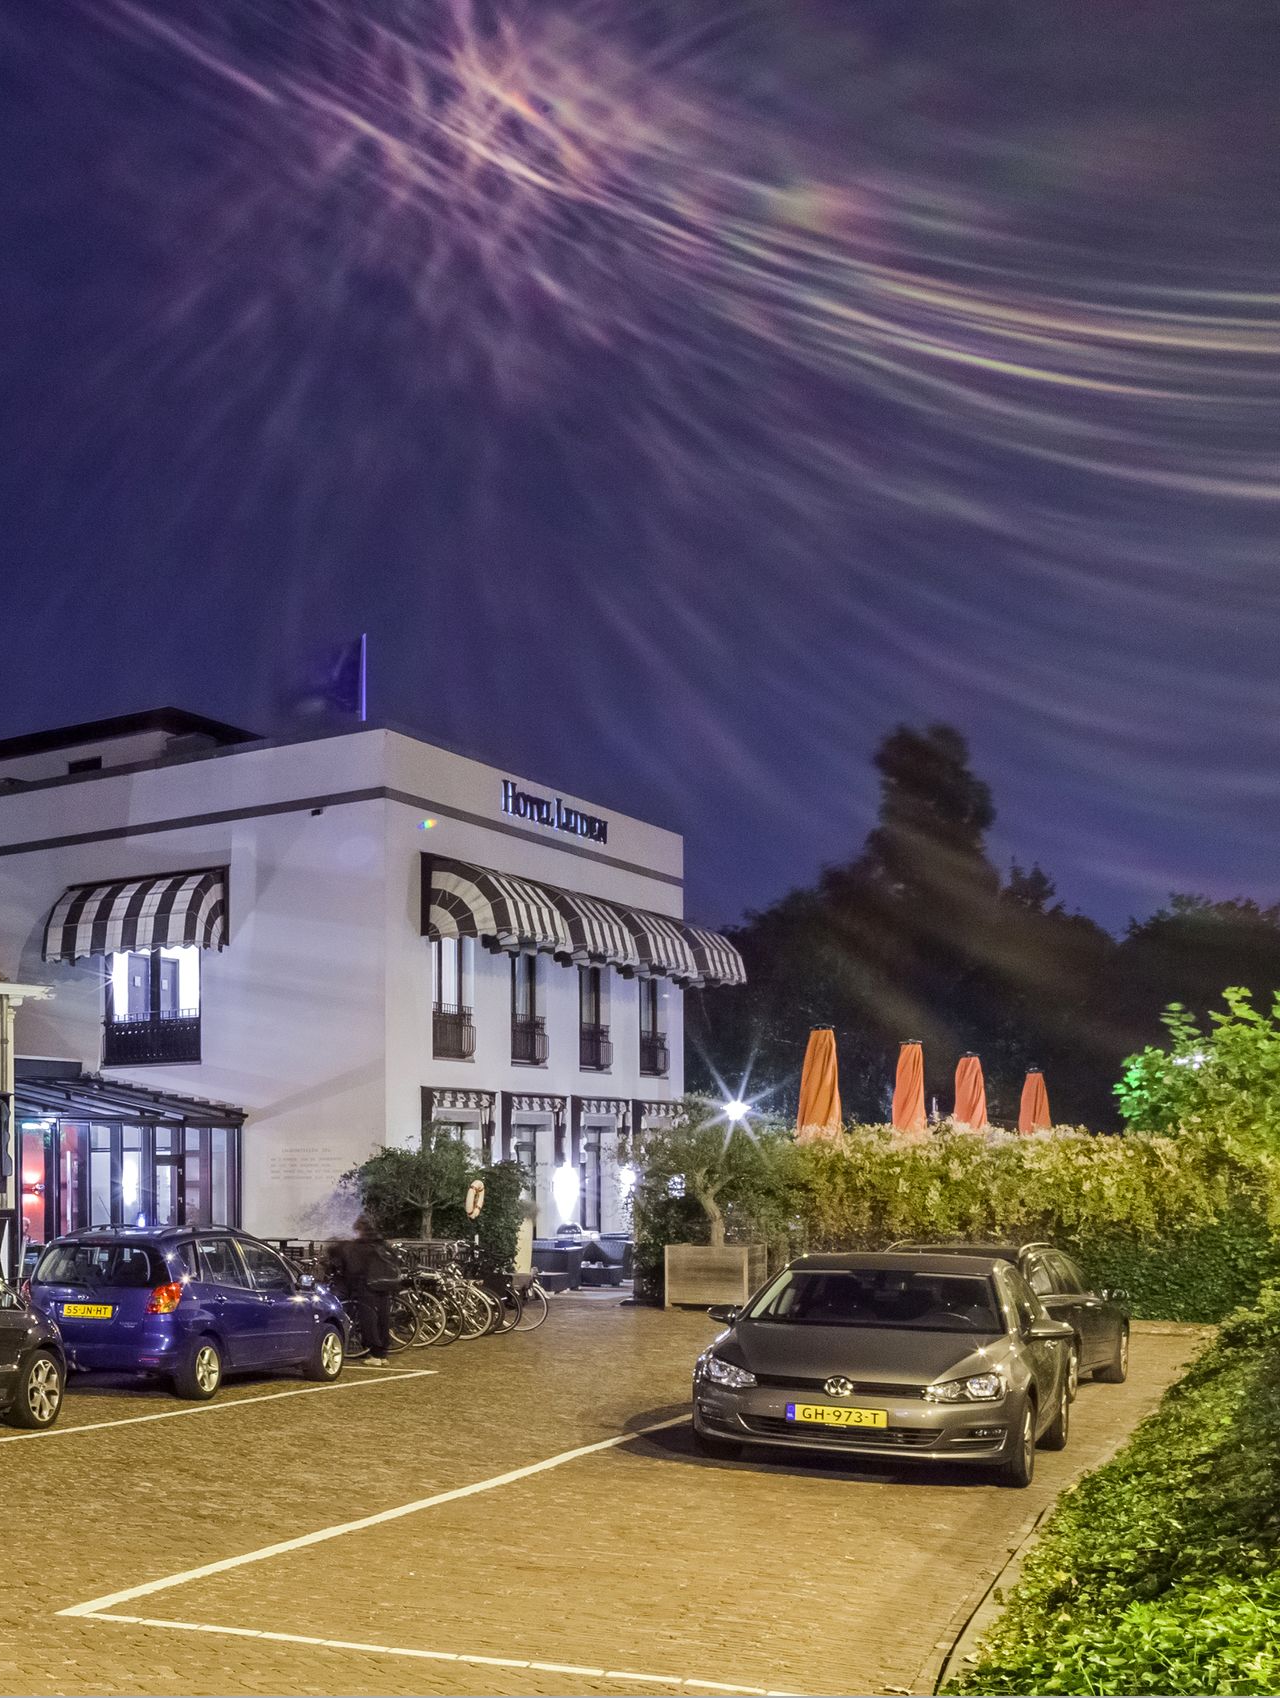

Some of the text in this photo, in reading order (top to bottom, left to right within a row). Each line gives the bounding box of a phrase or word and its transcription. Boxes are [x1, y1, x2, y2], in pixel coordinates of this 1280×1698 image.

[501, 779, 609, 845] HOTEL LEIDEN
[66, 1305, 109, 1315] 55-JN-HT
[802, 1407, 880, 1425] GH-973-T
